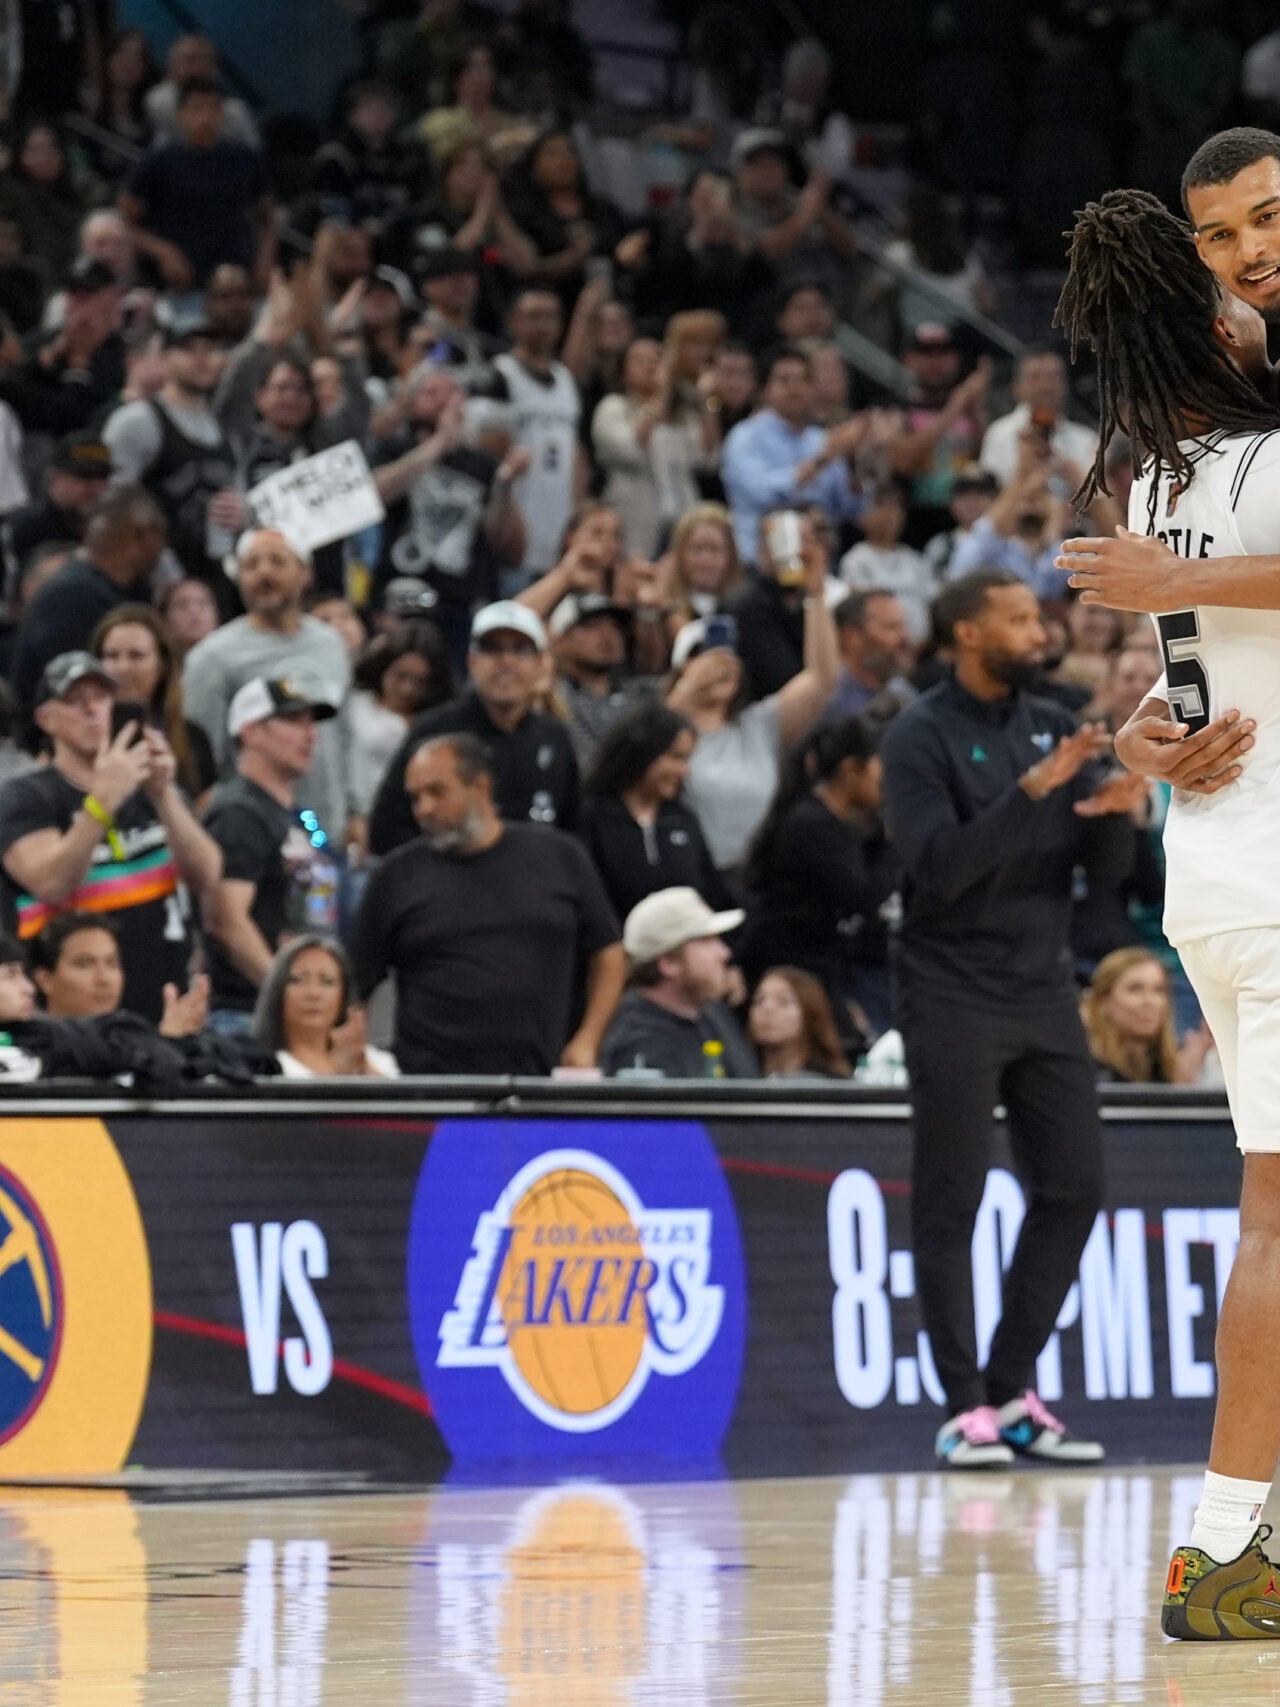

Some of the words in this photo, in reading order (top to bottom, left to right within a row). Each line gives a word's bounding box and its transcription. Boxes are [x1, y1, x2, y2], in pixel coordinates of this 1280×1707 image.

[1155, 606, 1211, 740] 5
[466, 1225, 697, 1355] LAKERS
[532, 1223, 583, 1247] LOS
[587, 1223, 696, 1247] ANGELES
[231, 1219, 333, 1396] VS
